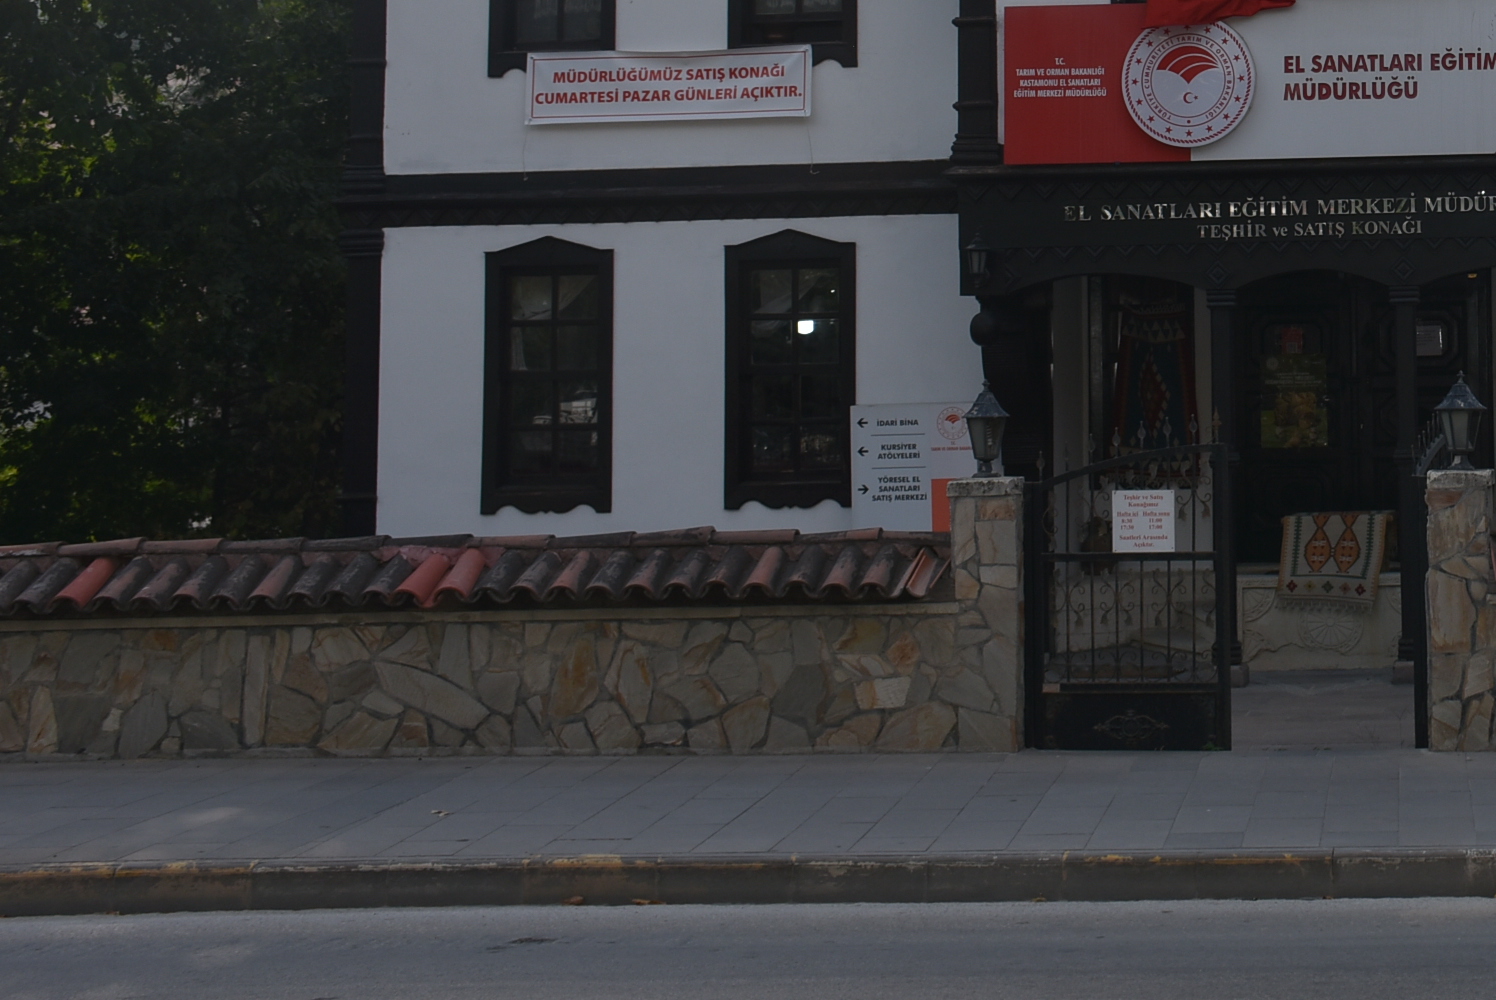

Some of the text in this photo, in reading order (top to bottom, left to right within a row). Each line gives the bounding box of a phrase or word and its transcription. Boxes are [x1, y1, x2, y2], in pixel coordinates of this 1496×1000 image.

[1071, 66, 1104, 75] BAKANLIĞI
[1283, 55, 1305, 73] EL
[1311, 53, 1423, 73] SANATLARI
[553, 63, 784, 84] MÜDÜRLÜĞÜMÜZ SATIŞ KONAĞI
[535, 84, 802, 104] CUMARTESİ PAZAR GÜNLERİ AÇIKTIR.
[1014, 87, 1106, 97] EĞİTİM MERKEZİ MÜDÜRLÜĞÜ
[1283, 76, 1418, 100] MÜDÜRLÜĞÜ
[1063, 205, 1091, 221] EL
[1100, 201, 1222, 221] SANATLARI
[1229, 196, 1308, 218] EĞİTİM
[1317, 193, 1416, 216] MERKEZİ
[1197, 216, 1422, 240] TEŞHİR ve SATIŞ KONAĞI
[877, 418, 897, 426] İDARİ
